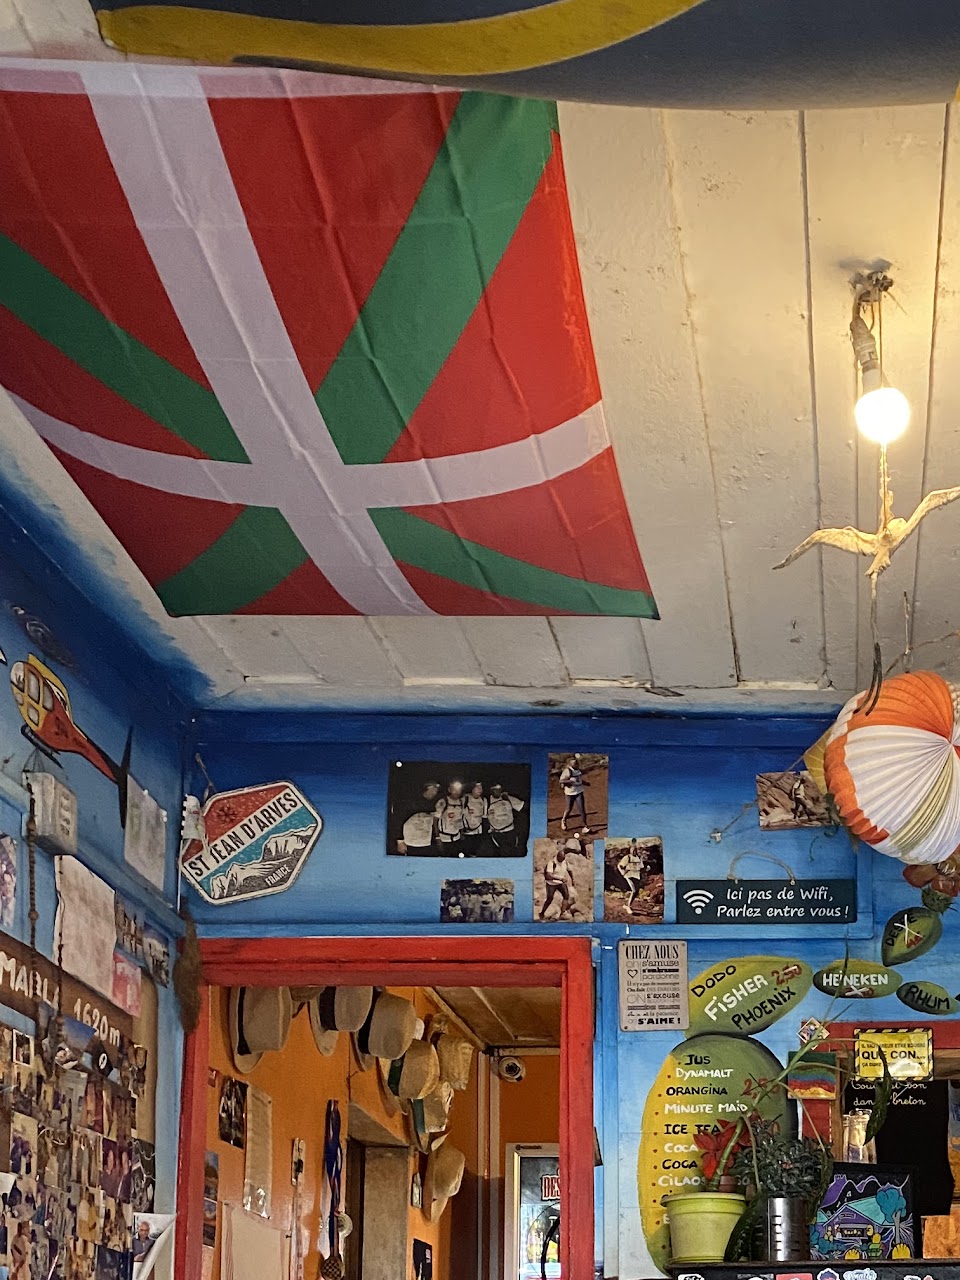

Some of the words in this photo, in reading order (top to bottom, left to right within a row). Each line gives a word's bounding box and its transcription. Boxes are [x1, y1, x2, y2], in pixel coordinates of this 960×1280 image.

[188, 855, 210, 877] ST
[210, 829, 245, 864] JEAN
[239, 792, 298, 838] D'ARVES
[265, 864, 292, 887] FRANCE
[727, 887, 744, 900] Ici
[748, 889, 773, 905] pas
[781, 887, 795, 900] de
[800, 886, 834, 902] Wifi,
[717, 905, 762, 917] Parlez
[766, 905, 805, 917] entre
[809, 906, 841, 917] vous
[625, 944, 651, 959] CHEZ
[654, 944, 679, 959] NOUS
[691, 965, 736, 998] DODO
[904, 985, 949, 1010] RHUM
[684, 1054, 711, 1065] JUS
[892, 1092, 926, 1105] breton
[664, 1100, 713, 1115] MINUTE
[718, 1100, 748, 1113] MAID
[664, 1124, 687, 1135] ICE
[664, 1143, 699, 1153] COCA
